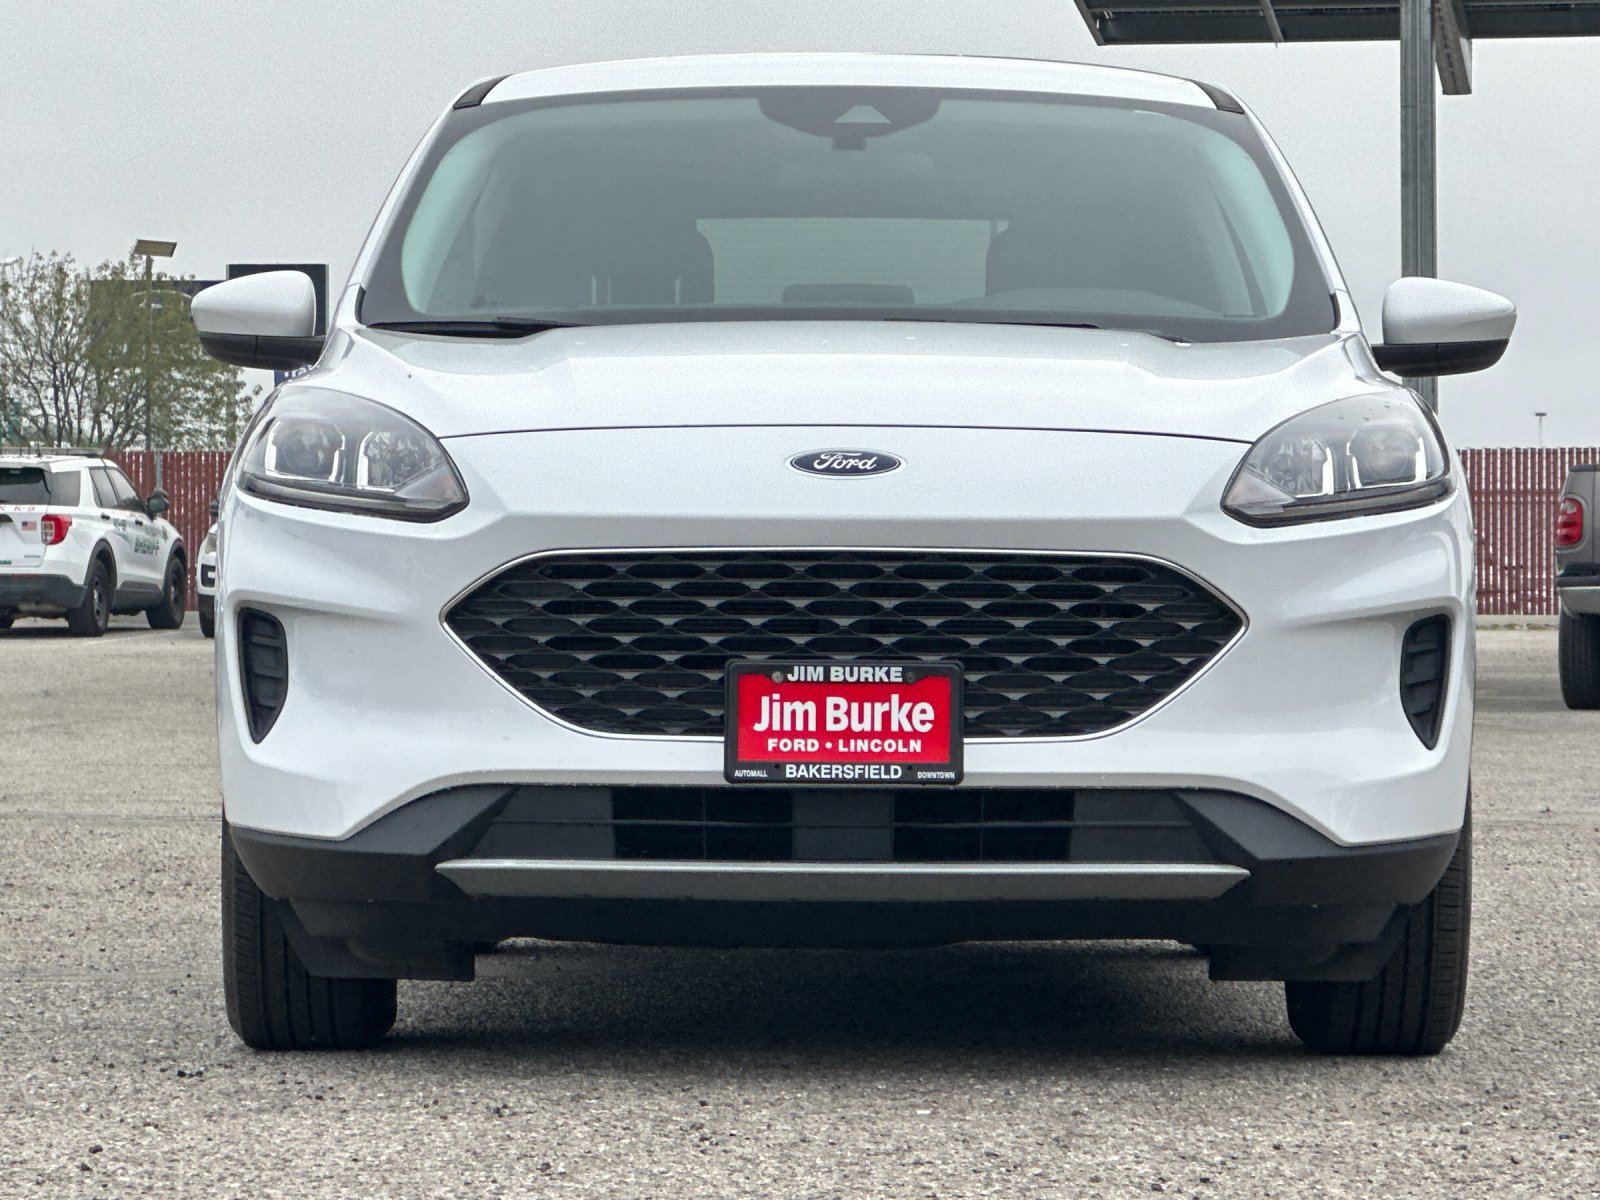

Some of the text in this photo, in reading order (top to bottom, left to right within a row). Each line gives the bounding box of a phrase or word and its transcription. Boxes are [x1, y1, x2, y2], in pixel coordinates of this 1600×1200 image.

[813, 452, 877, 470] Ford
[787, 666, 903, 682] JIM BURKE
[753, 693, 935, 733] Jim Burke
[767, 738, 922, 753] FORD LINCOLN
[734, 769, 768, 778] AUTOMALL
[785, 764, 902, 779] BAKERSFIELD
[917, 771, 956, 779] DOWNTOWN
